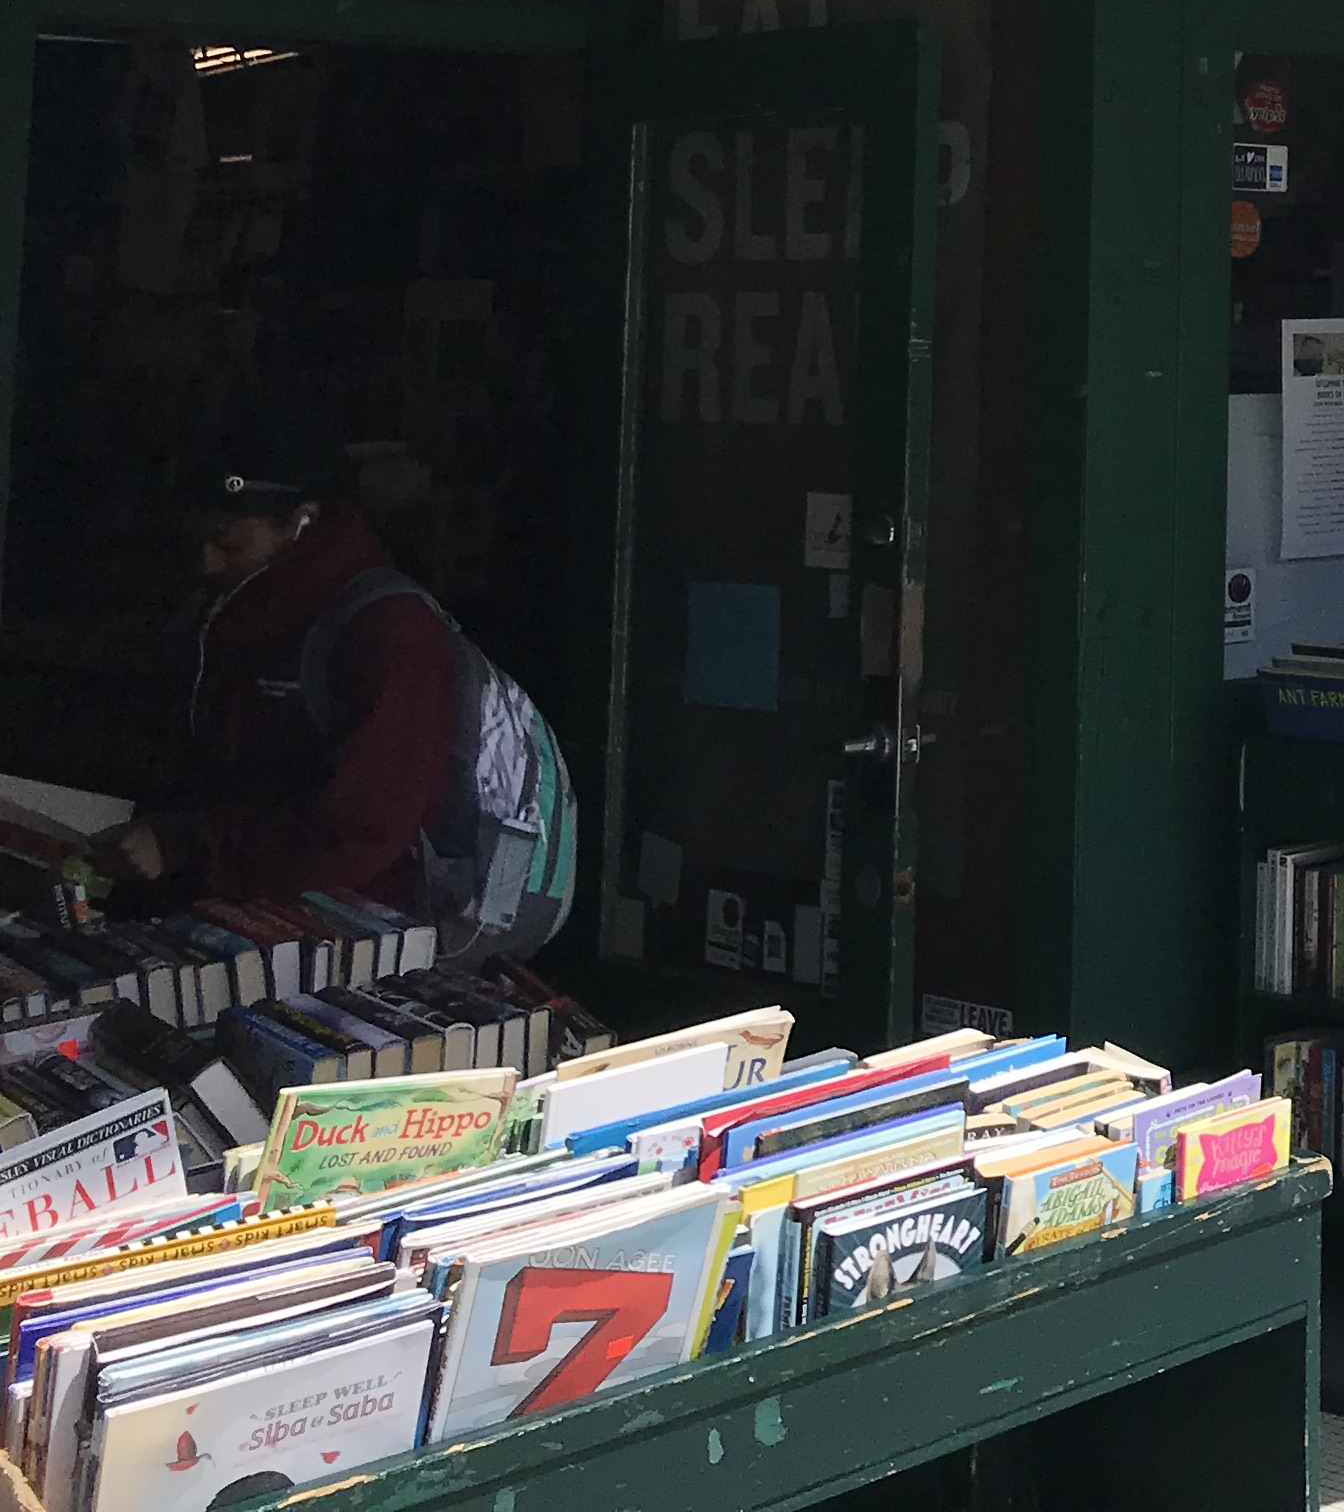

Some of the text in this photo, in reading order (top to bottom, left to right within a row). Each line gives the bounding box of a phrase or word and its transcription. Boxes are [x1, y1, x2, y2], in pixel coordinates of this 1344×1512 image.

[664, 120, 973, 266] SLEP
[661, 291, 861, 426] REA
[1278, 688, 1306, 705] ANT
[77, 1103, 162, 1149] DICTIONARIES
[291, 1114, 370, 1152] Duck
[399, 1107, 492, 1140] Hippo
[318, 1141, 453, 1170] LOST AND FOUND
[1040, 1178, 1105, 1214] ABIGAIL
[604, 1248, 677, 1273] AGEE
[834, 1213, 981, 1290] STRONGHEART
[492, 1266, 675, 1421] 7
[248, 1416, 308, 1452] Siba
[327, 1391, 395, 1427] Saba
[264, 1374, 388, 1422] SLEEP WELL
